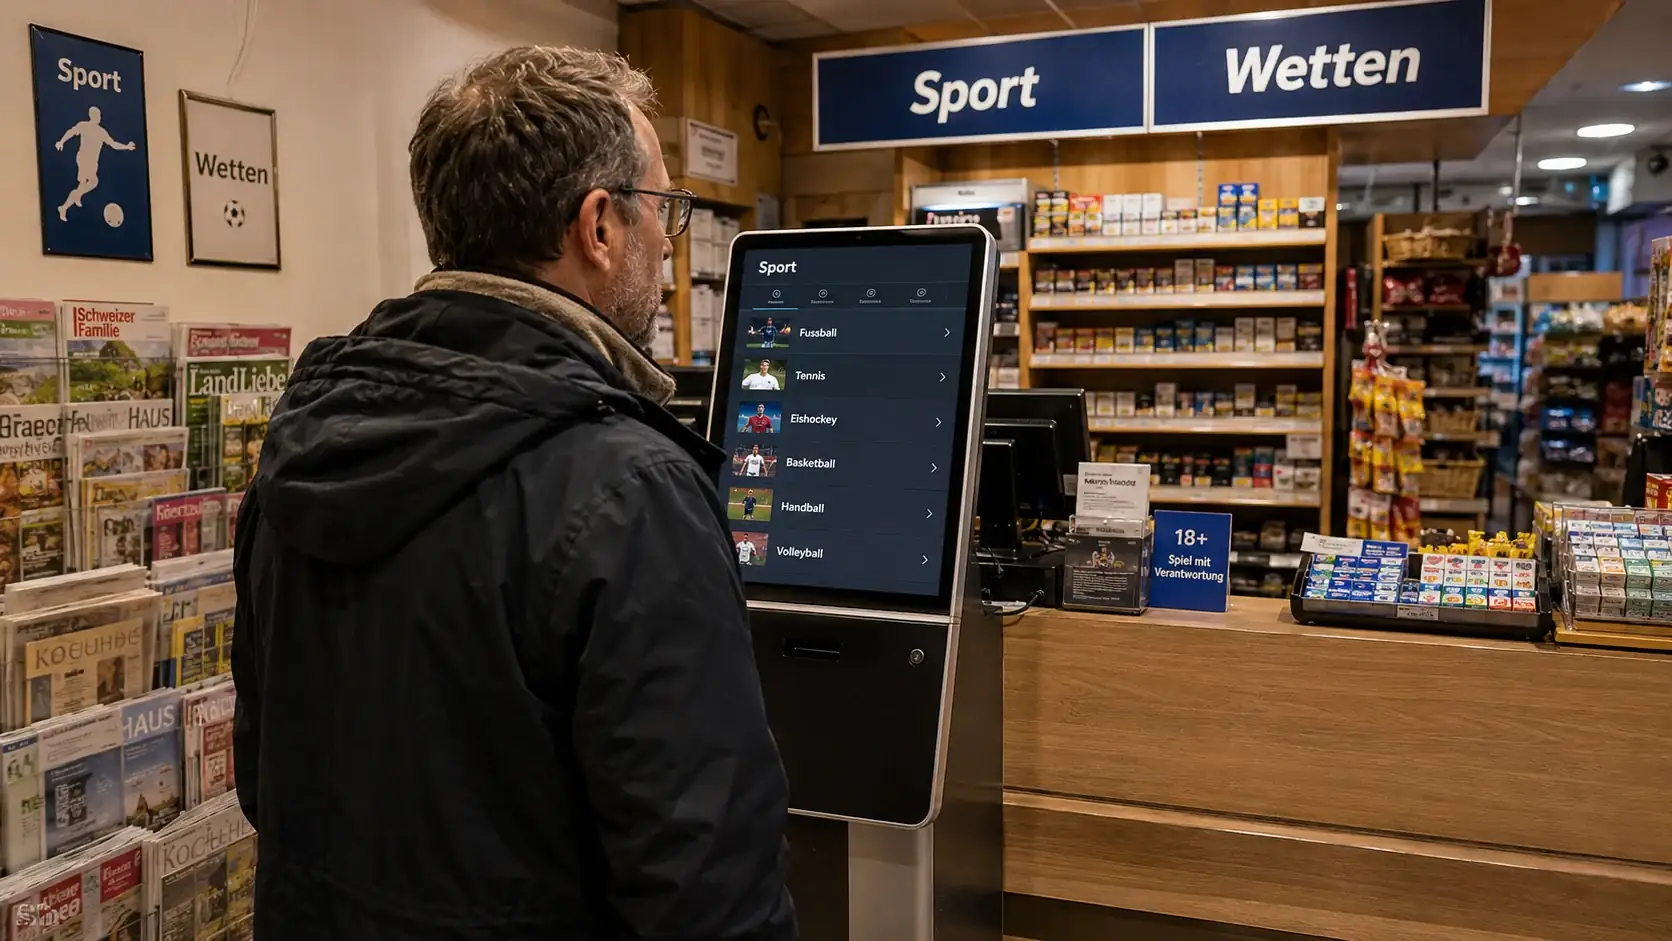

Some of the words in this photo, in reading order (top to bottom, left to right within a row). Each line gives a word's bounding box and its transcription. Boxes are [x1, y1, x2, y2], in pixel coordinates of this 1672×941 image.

[57, 57, 122, 93] Sport
[1225, 43, 1420, 95] Wetten
[909, 66, 1040, 124] Sport
[195, 151, 268, 185] Wetten
[758, 260, 797, 277] Sport
[77, 306, 136, 324] Schweizer
[78, 322, 120, 338] Familie
[799, 327, 838, 339] Fussball
[795, 370, 826, 382] Tennis
[128, 406, 170, 430] HAUS
[790, 413, 838, 427] Eishockey
[786, 457, 836, 470] Basketball
[781, 501, 825, 514] Handball
[1174, 528, 1208, 546] 18+
[776, 546, 824, 560] Volleyball
[1168, 554, 1193, 567] Spiel
[1194, 556, 1212, 568] mit
[1154, 567, 1225, 584] Verantwortung
